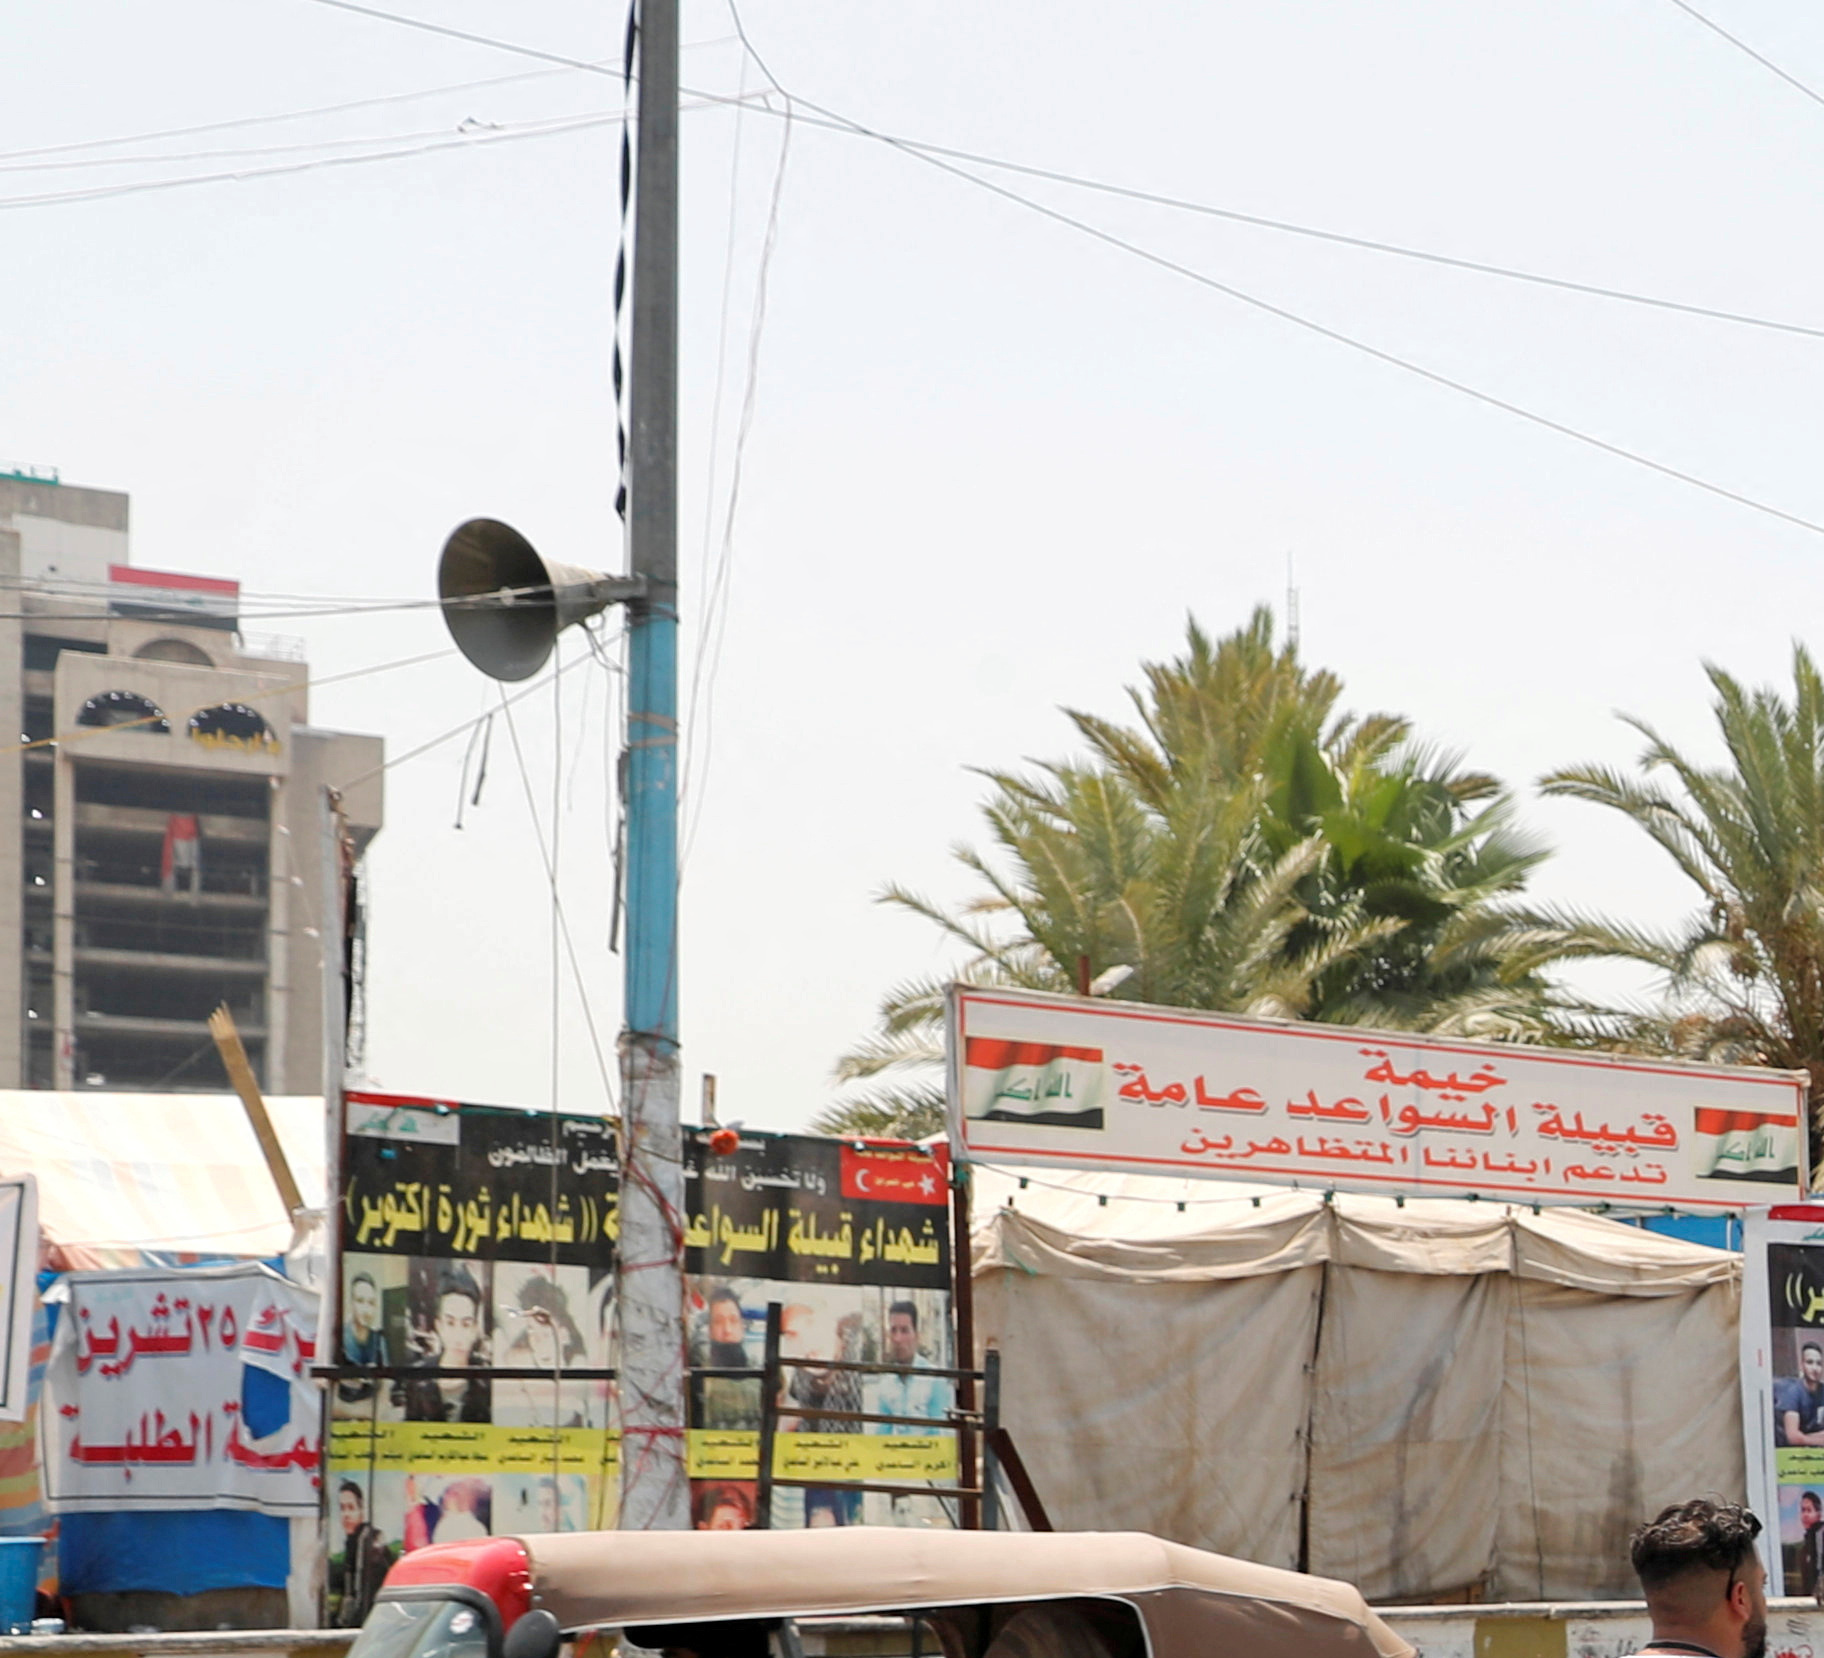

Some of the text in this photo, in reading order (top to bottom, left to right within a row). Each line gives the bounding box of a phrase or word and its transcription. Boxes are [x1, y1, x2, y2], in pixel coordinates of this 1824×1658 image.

[1361, 1049, 1507, 1102] خيمة
[1115, 1063, 1679, 1154] قبيلة السواعد عامة
[1181, 1130, 1408, 1164] المتظاهرين
[1563, 1164, 1668, 1185] تدعم
[437, 1184, 491, 1254] ثورة
[787, 1208, 853, 1275] قبيلة
[859, 1217, 940, 1266] شهداء
[75, 1291, 194, 1377] تشرين
[197, 1303, 239, 1348] ٢٥
[59, 1404, 212, 1483] الطلبة
